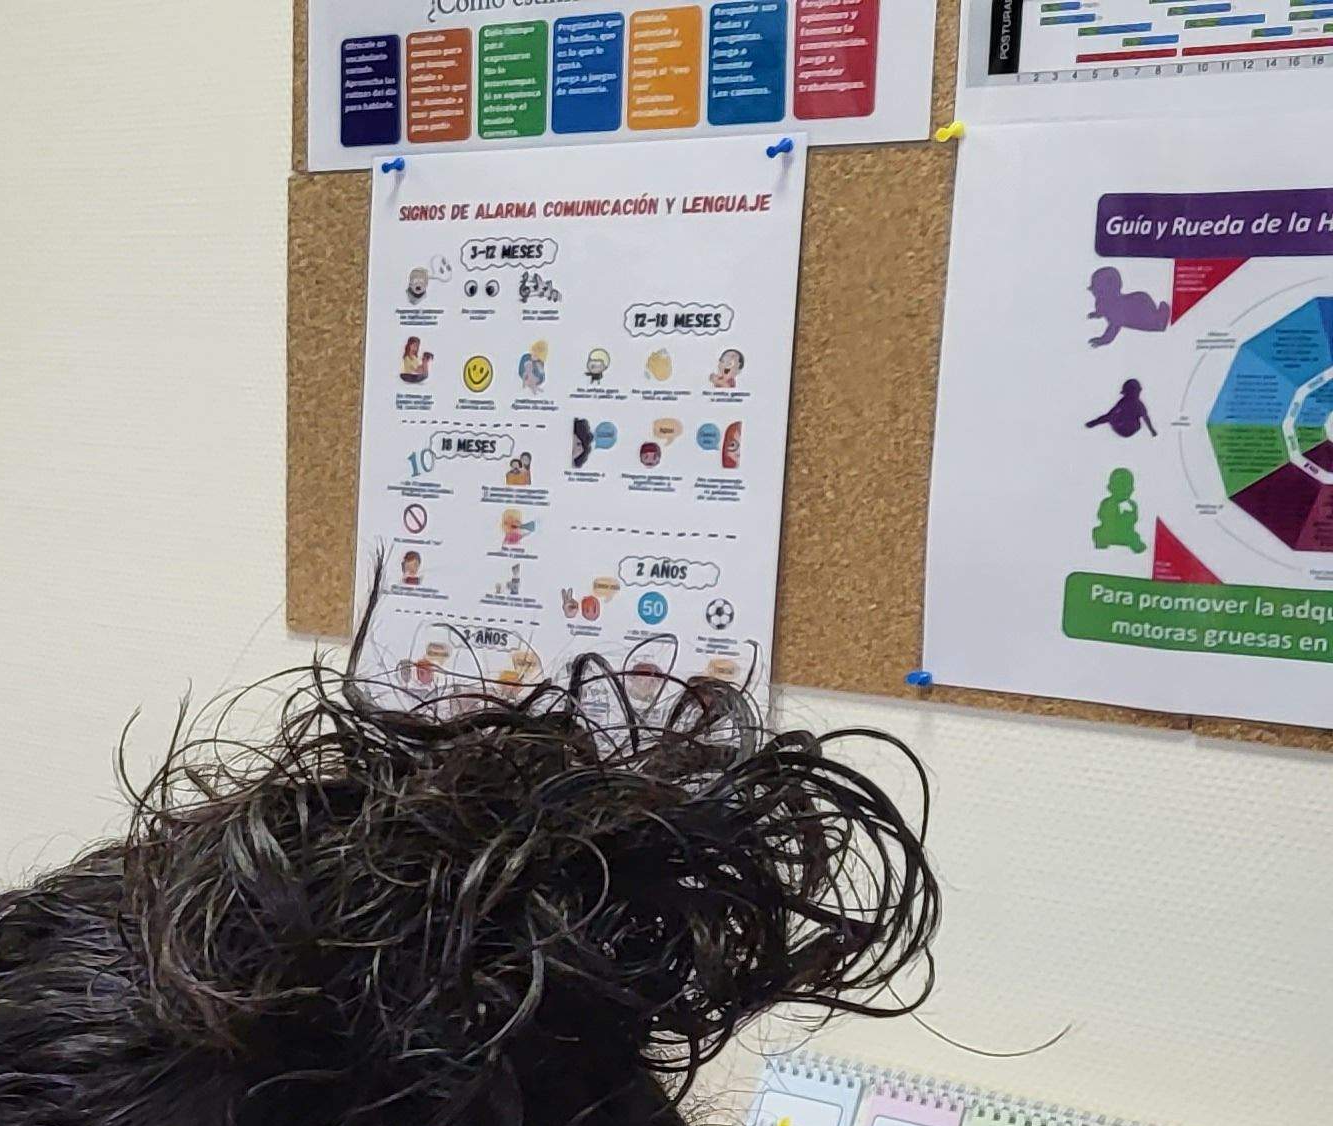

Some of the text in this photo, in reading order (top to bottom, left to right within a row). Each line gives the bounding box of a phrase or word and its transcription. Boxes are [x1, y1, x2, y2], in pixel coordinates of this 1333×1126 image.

[399, 193, 772, 222] SIGNOS DE ALARMA COMUNICACIÓN Y LENGUAJE
[1106, 215, 1152, 235] Guía
[1156, 220, 1168, 240] y
[1172, 214, 1244, 236] Rueda
[1251, 213, 1282, 233] de
[1287, 211, 1312, 233] la
[501, 243, 544, 260] MESES
[674, 312, 723, 329] MESES
[456, 438, 496, 454] MESES
[650, 561, 688, 580] AÑOS
[642, 602, 664, 617] 50
[1091, 584, 1134, 605] Para
[1139, 594, 1249, 616] promover
[1254, 597, 1275, 617] la
[1111, 620, 1328, 652] motoras gruesas en
